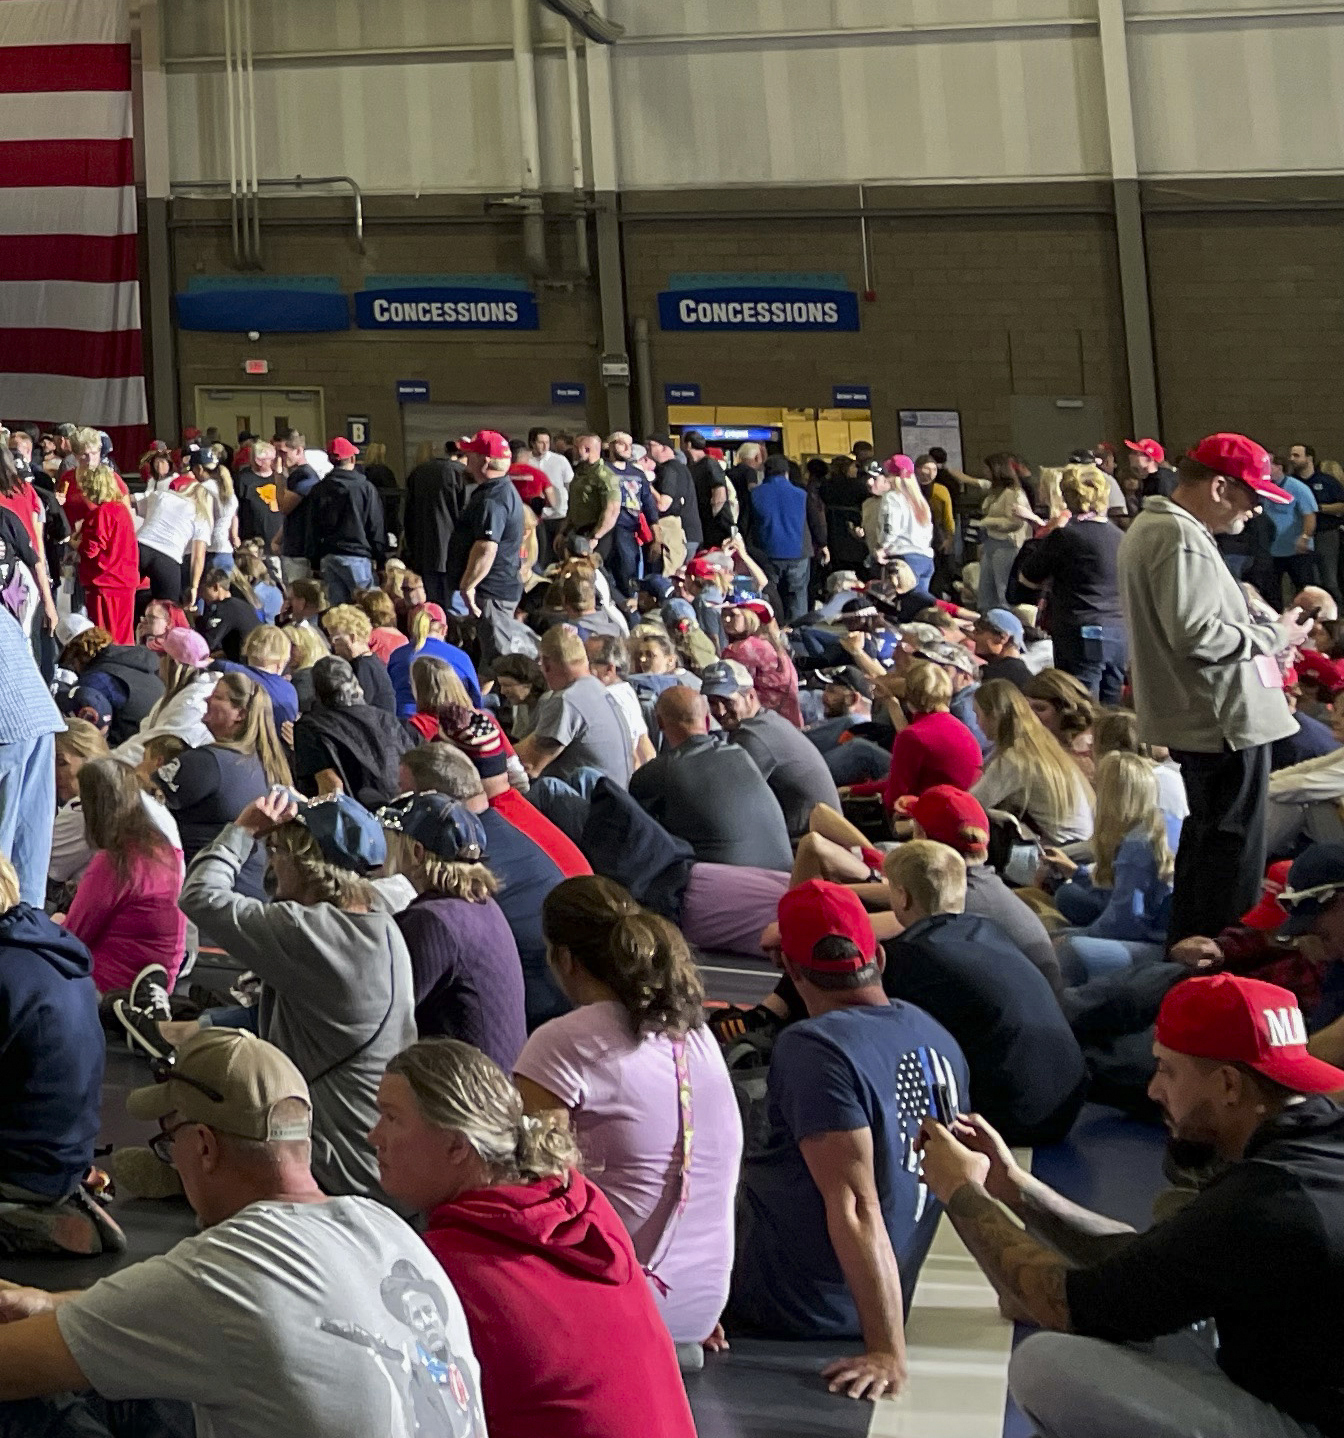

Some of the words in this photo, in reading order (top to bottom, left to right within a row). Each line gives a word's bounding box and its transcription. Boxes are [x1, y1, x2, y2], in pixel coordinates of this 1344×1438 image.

[373, 299, 518, 322] CONCESSIONS
[679, 299, 839, 323] CONCESSIONS
[352, 423, 365, 443] B
